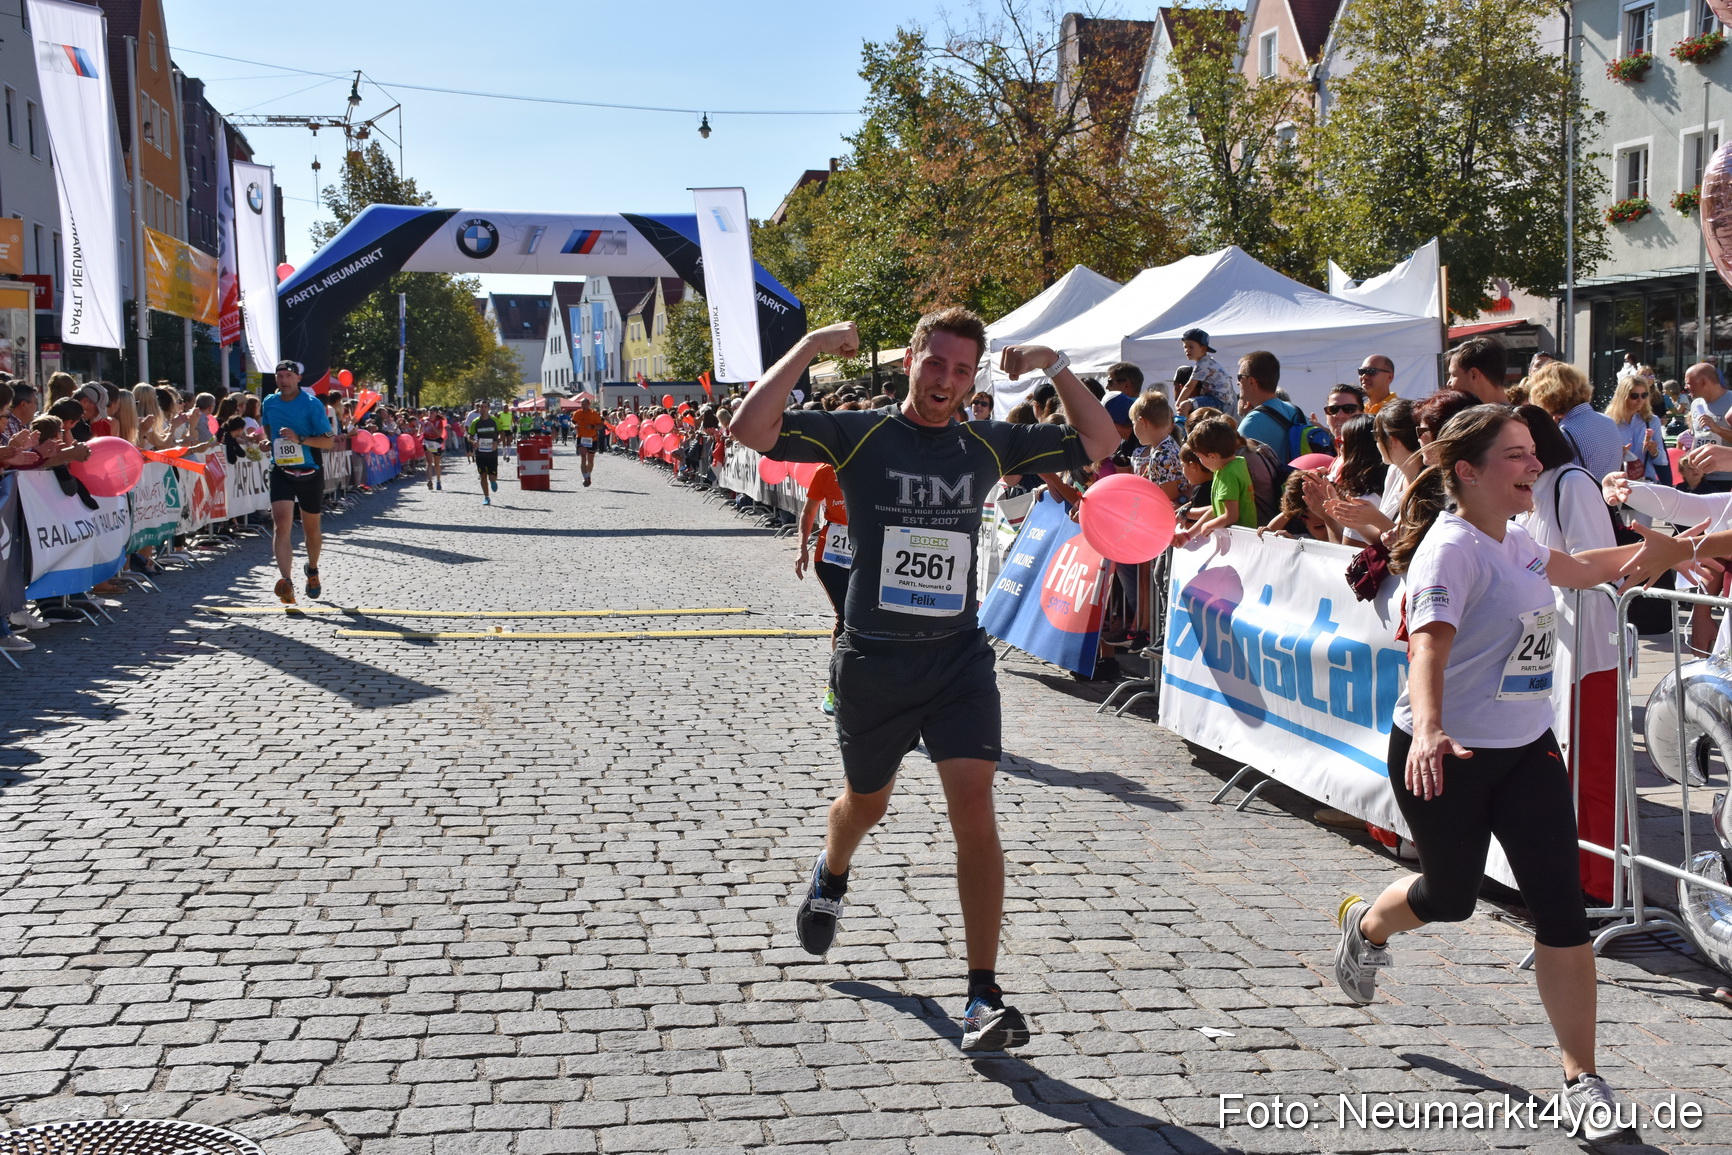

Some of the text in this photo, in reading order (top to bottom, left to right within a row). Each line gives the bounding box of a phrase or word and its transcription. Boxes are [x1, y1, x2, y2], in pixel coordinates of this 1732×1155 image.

[0, 244, 10, 259] E
[285, 246, 385, 309] PARTL NEUMARKT
[754, 289, 790, 316] MARKT
[280, 445, 296, 455] 180
[875, 504, 913, 514] RUNNERS
[914, 507, 934, 515] HIGH
[902, 516, 959, 525] EST. 2007
[909, 535, 949, 547] BOCK
[894, 550, 956, 581] 2561
[1012, 552, 1035, 569] NLINE
[898, 579, 945, 590] PARTL Neumarkt
[997, 577, 1024, 597] OBILE
[910, 593, 936, 607] Felix
[1047, 595, 1071, 616] SPORTS
[1520, 664, 1538, 672] PARTL
[1528, 676, 1548, 691] Katja
